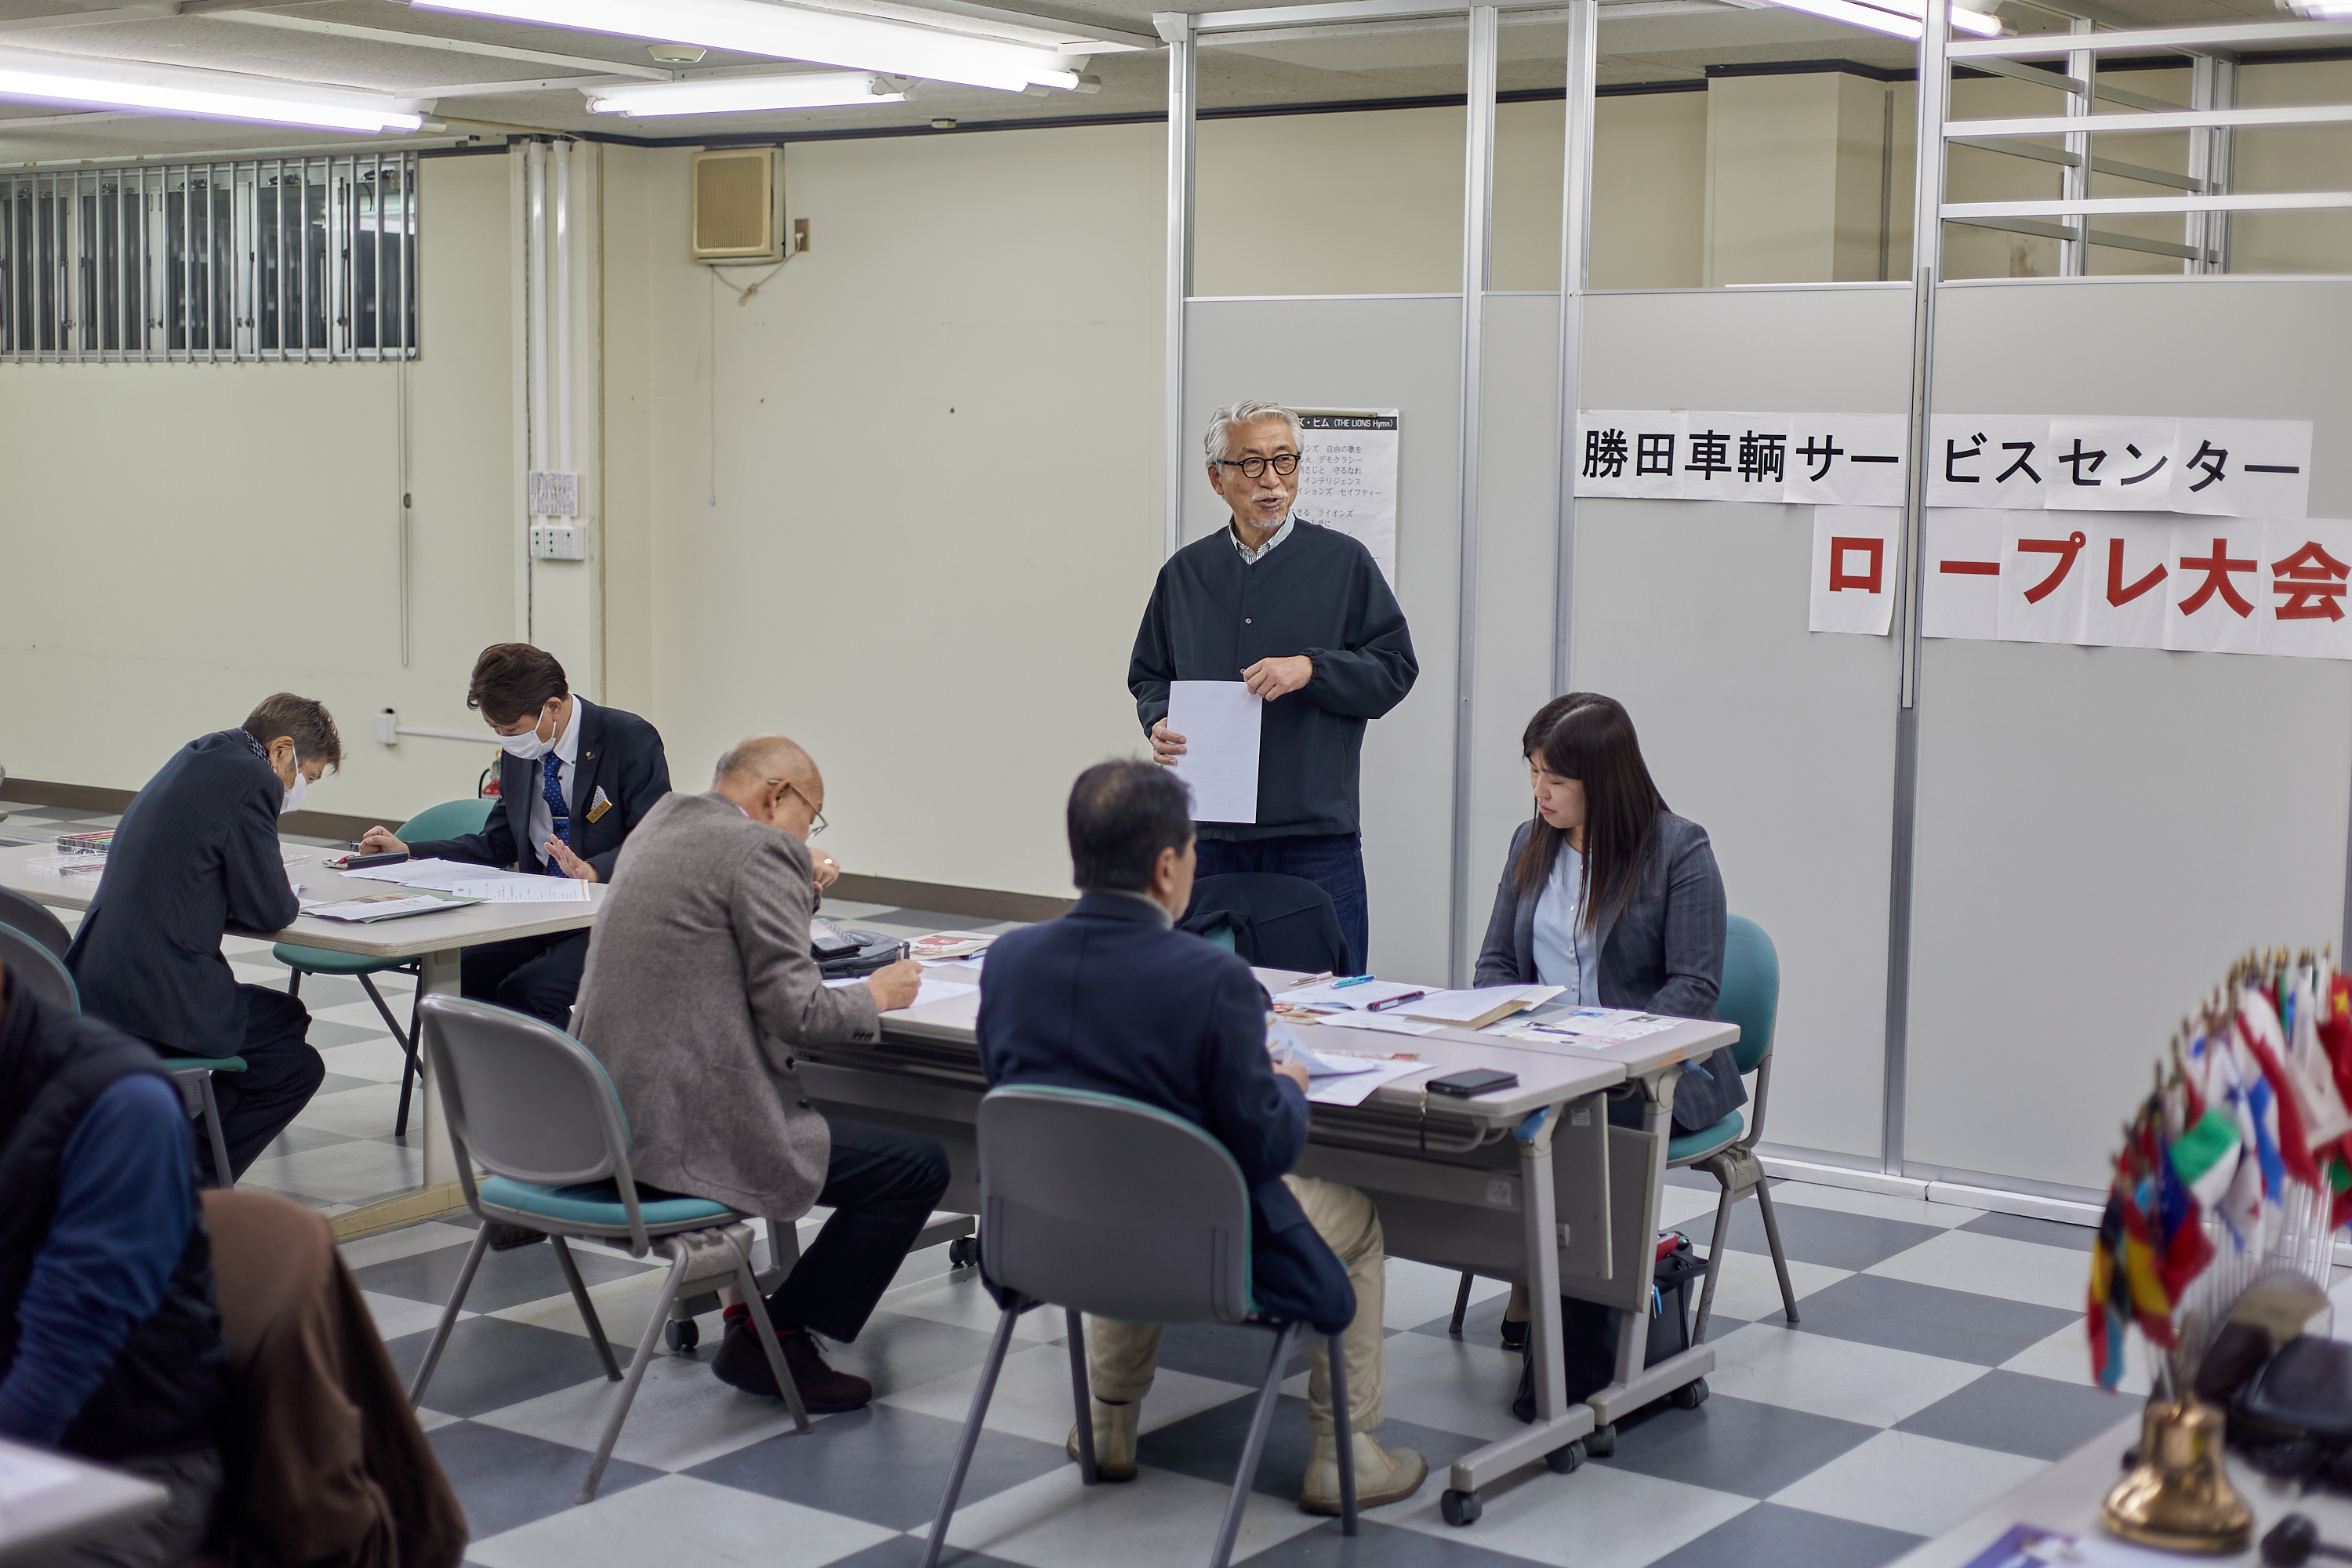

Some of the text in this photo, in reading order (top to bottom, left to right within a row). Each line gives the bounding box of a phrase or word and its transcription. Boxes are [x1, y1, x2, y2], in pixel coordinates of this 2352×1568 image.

[1373, 419, 1393, 429] Hymn)
[1327, 445, 1363, 454] 自由の歌を
[1319, 455, 1363, 464] デモクラシー
[1333, 466, 1362, 475] 守るなれ
[1305, 477, 1361, 486] インテリジェンス
[1340, 488, 1381, 497] セイフティー
[1318, 509, 1354, 518] ライオンズ
